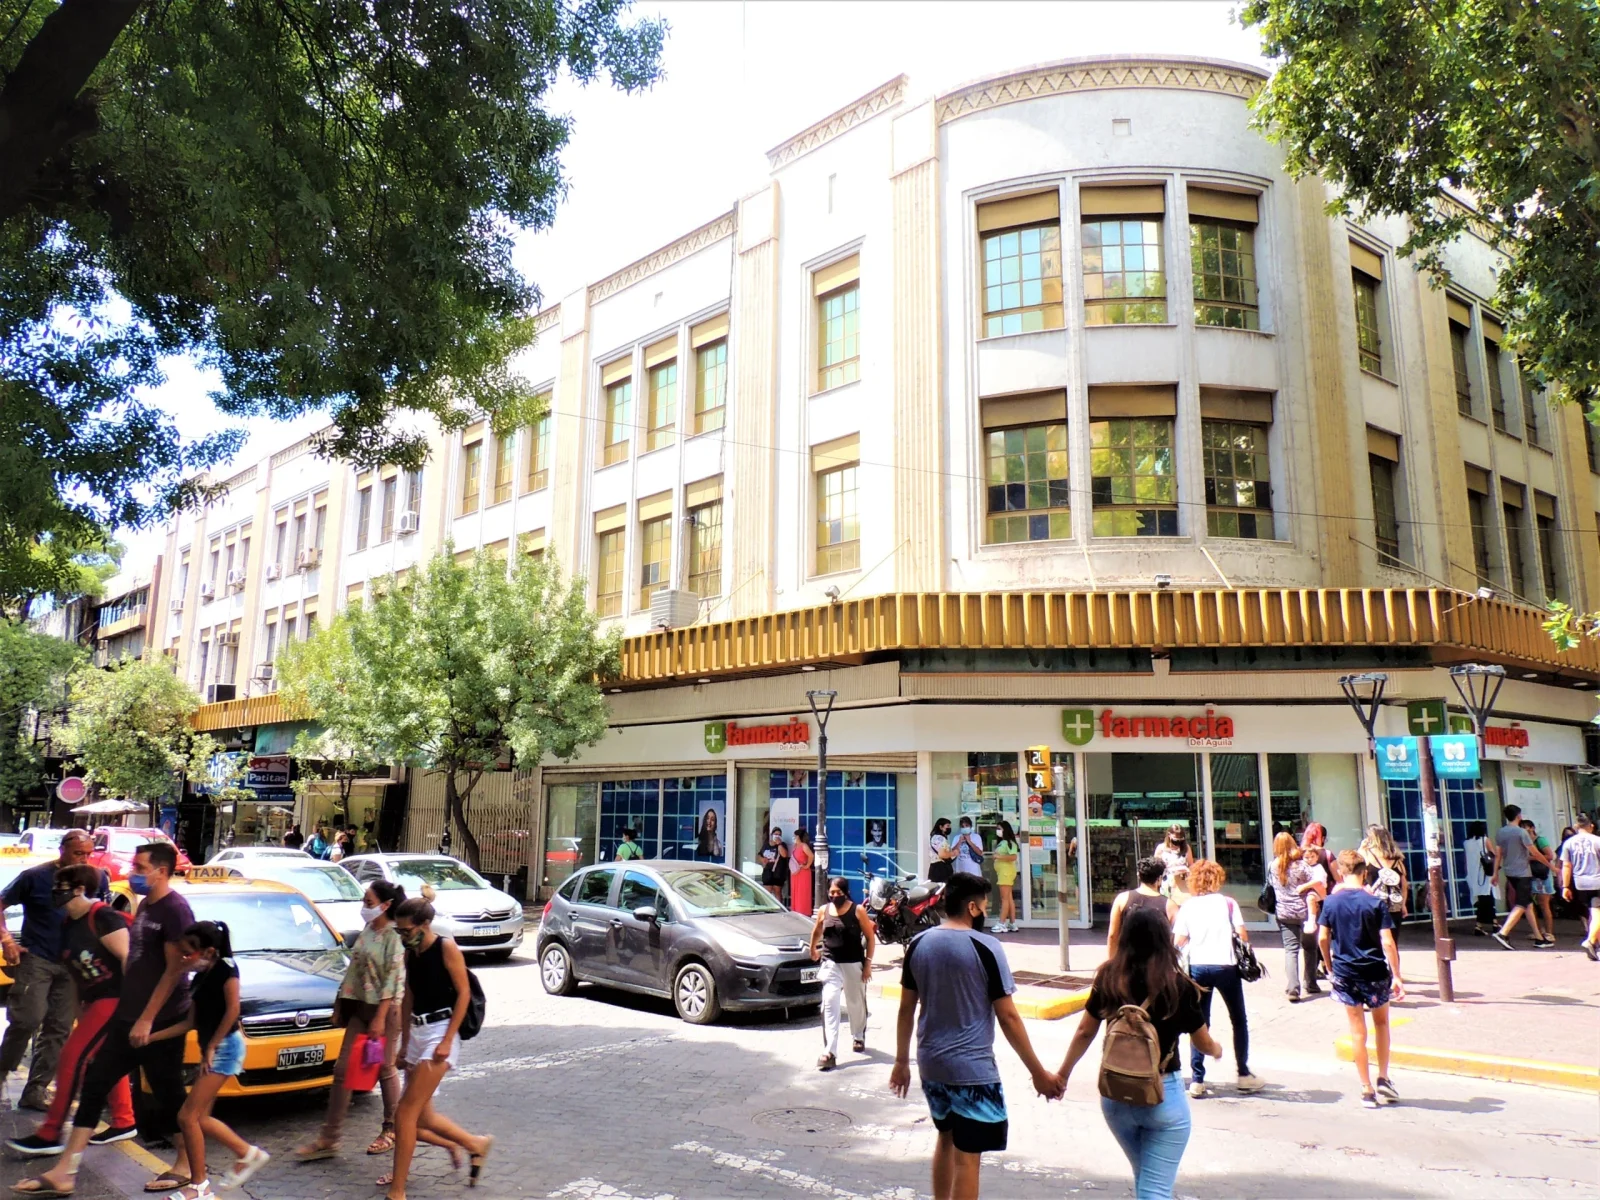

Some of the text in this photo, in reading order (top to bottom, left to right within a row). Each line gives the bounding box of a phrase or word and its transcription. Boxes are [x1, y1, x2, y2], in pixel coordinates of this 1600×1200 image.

[1099, 709, 1234, 740] farmacia
[726, 716, 809, 746] farmacia
[1190, 738, 1233, 748] Del Aguila
[249, 773, 287, 782] Patitas
[3, 847, 27, 855] TAXI
[192, 867, 224, 878] TAXI
[279, 1049, 323, 1067] NUY 598
